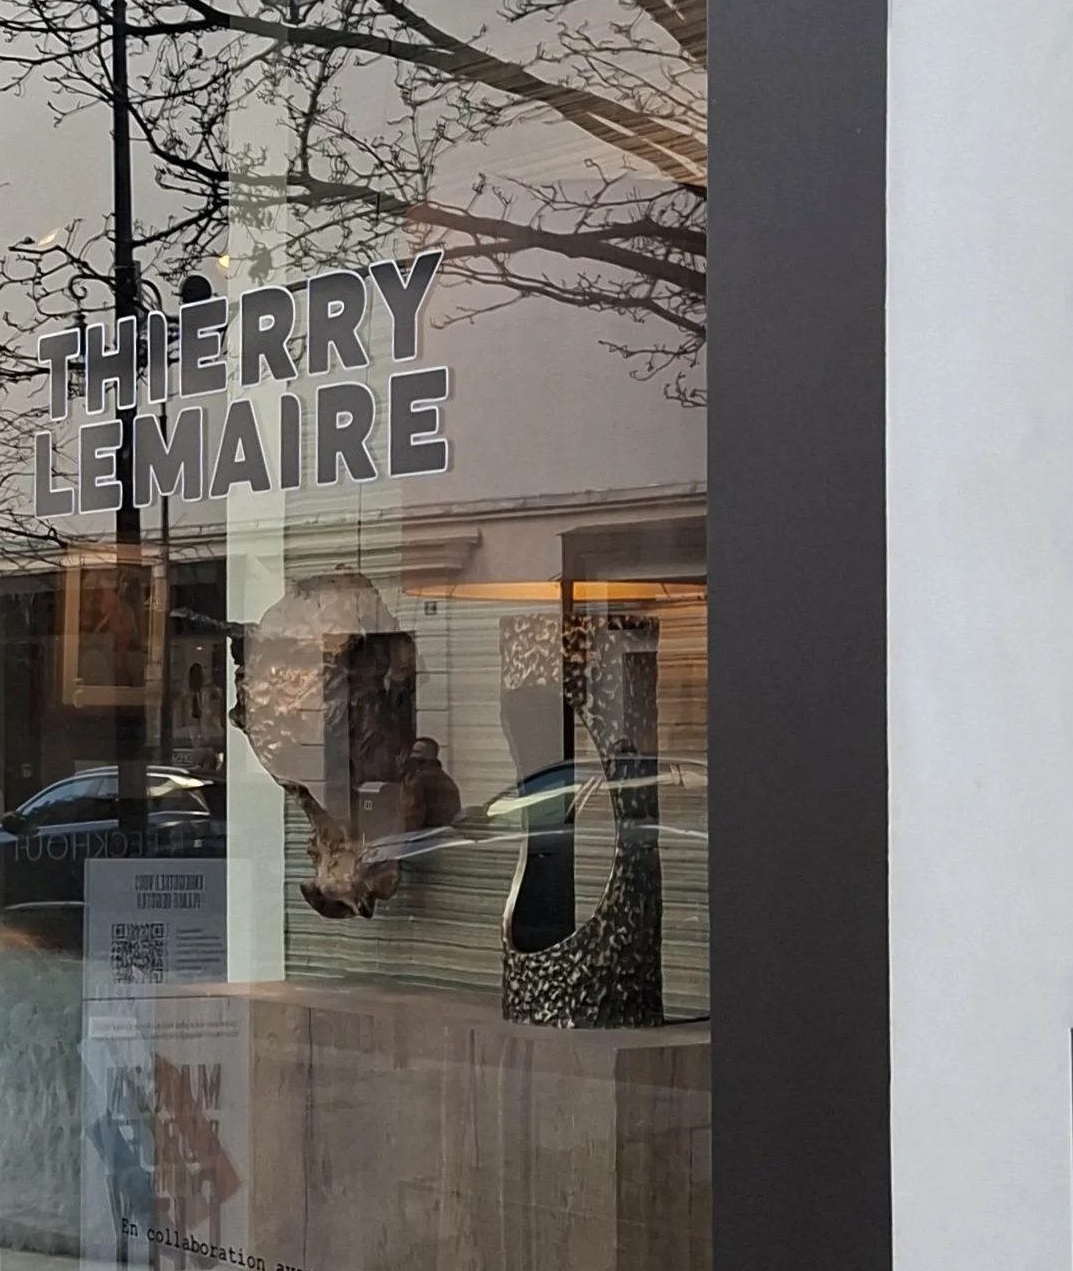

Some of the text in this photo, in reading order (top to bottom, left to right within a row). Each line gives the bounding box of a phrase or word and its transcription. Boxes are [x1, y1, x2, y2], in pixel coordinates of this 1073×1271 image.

[37, 249, 446, 422] THIERRY
[33, 366, 450, 519] LEMAIRE
[121, 1218, 139, 1238] En
